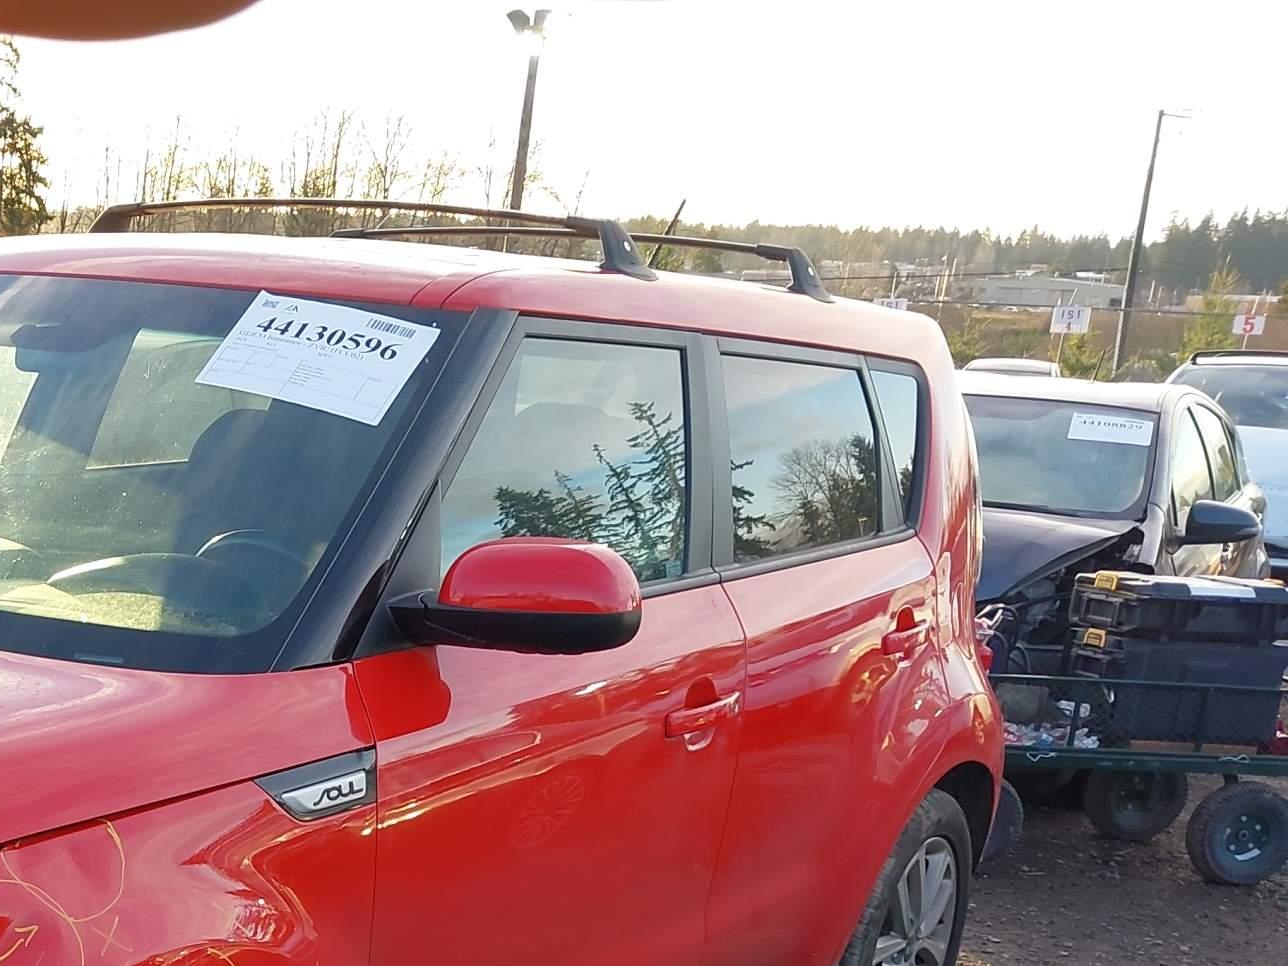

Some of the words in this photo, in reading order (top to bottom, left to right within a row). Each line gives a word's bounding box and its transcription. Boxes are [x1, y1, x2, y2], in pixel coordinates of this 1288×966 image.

[1242, 316, 1256, 333] 5
[257, 316, 403, 361] 44130596
[313, 781, 364, 807] SOUL
